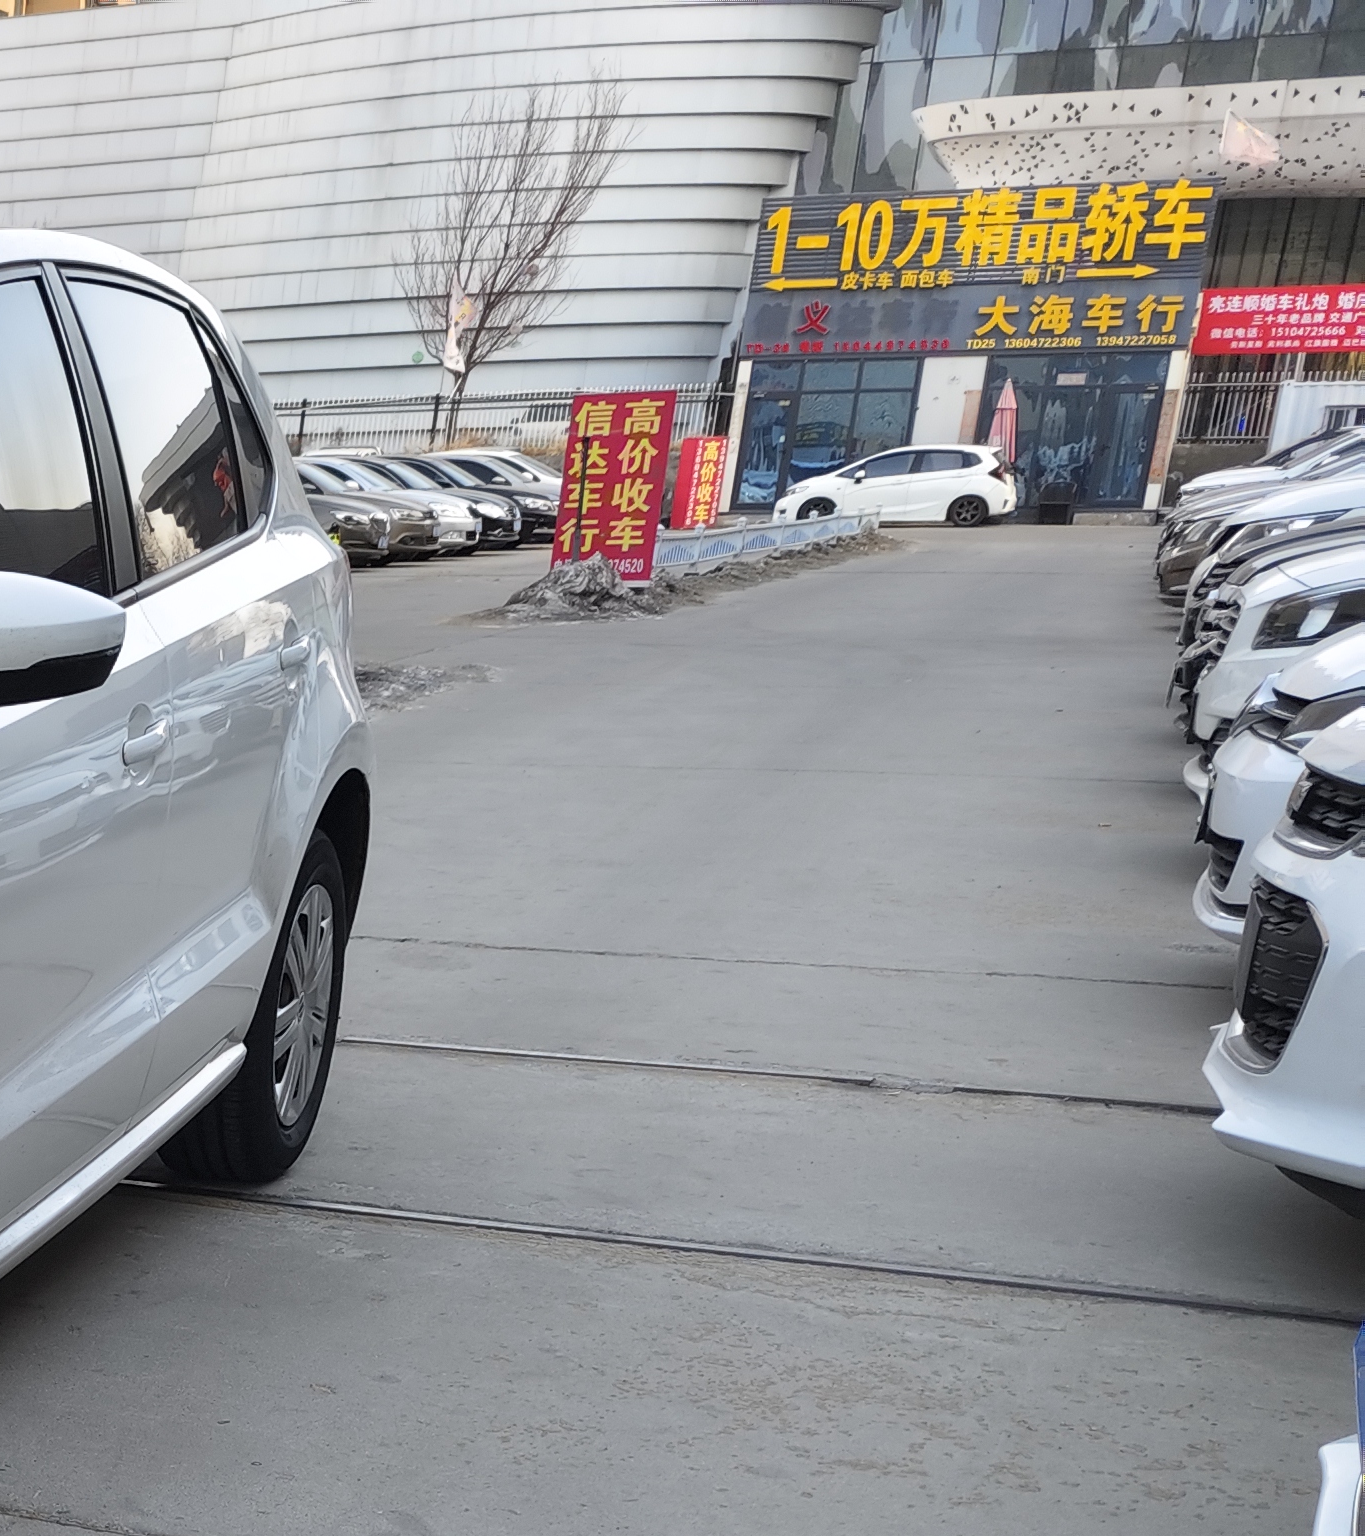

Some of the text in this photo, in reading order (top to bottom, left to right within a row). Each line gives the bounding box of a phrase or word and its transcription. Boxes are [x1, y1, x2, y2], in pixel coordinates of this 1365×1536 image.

[766, 178, 1215, 275] 1-10万精品轿车
[841, 265, 1067, 291] 皮卡车 面包车 南门
[973, 293, 1186, 338] 大海车行
[1251, 313, 1326, 326] 三十年老品牌
[1270, 325, 1347, 338] 15104725666
[966, 334, 1177, 350] TD25 13604722306 13947227058
[558, 400, 618, 554] 信达车行
[604, 398, 666, 553] 高价收车
[693, 441, 721, 525] 高价收车
